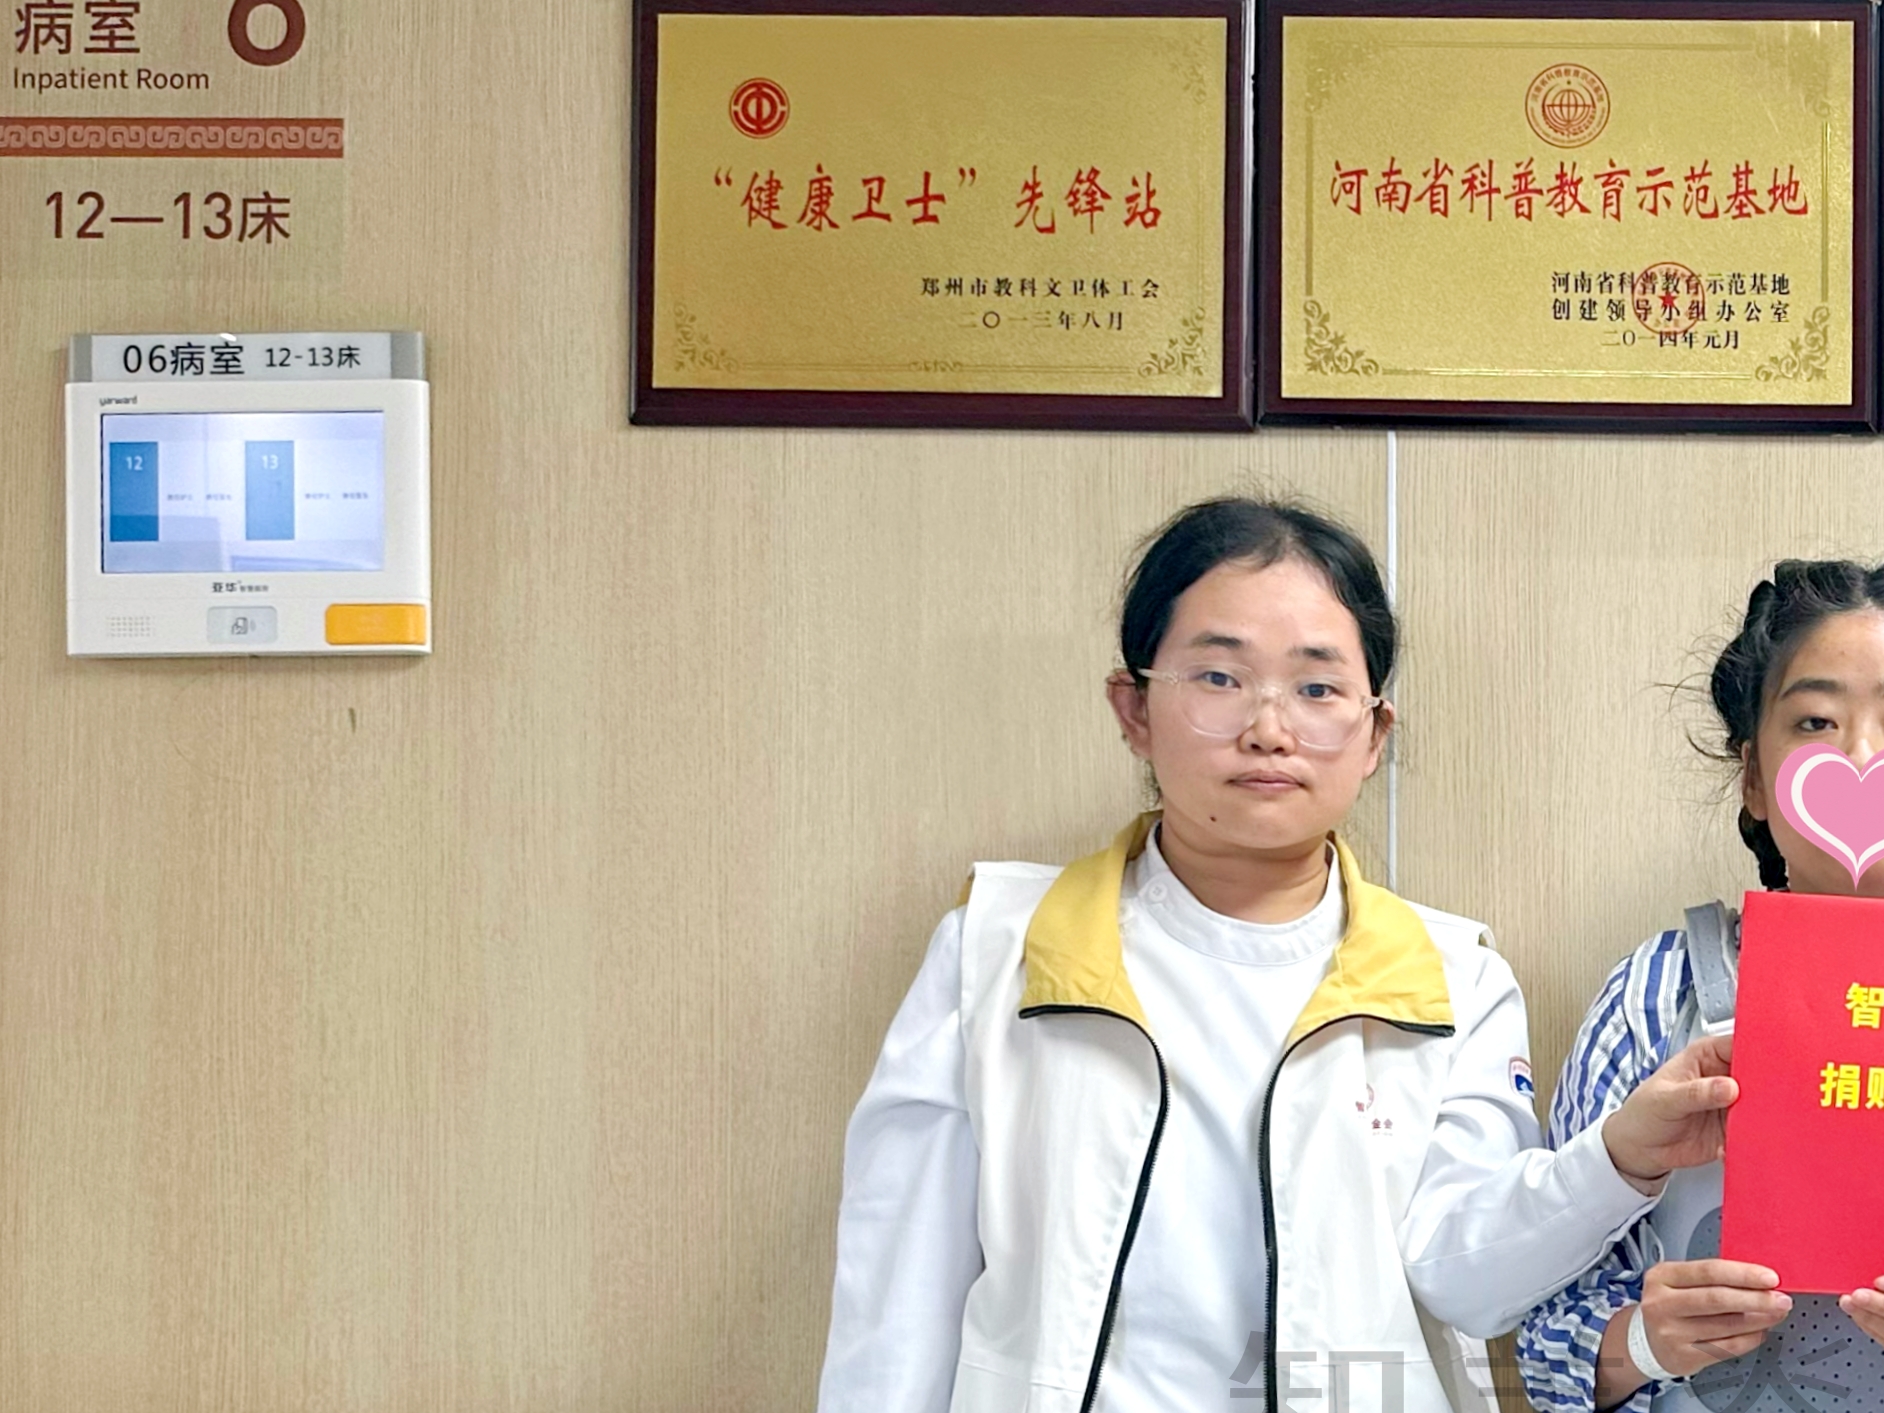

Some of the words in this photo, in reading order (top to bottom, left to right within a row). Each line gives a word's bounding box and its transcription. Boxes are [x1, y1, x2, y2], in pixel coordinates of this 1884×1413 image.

[15, 0, 141, 55] 病室
[13, 67, 128, 94] Inpatient
[137, 68, 210, 89] Room
[1330, 157, 1809, 222] 河南省科普教育示范基地
[921, 277, 1160, 298] 郑州市教科文卫体工会
[1551, 271, 1791, 296] 河南省科普教育示范基地
[1551, 298, 1791, 323] 创建领导小组办公室
[122, 341, 245, 377] 06病室
[265, 344, 361, 369] 12-13床
[126, 457, 143, 471] 12
[262, 456, 279, 471] 13
